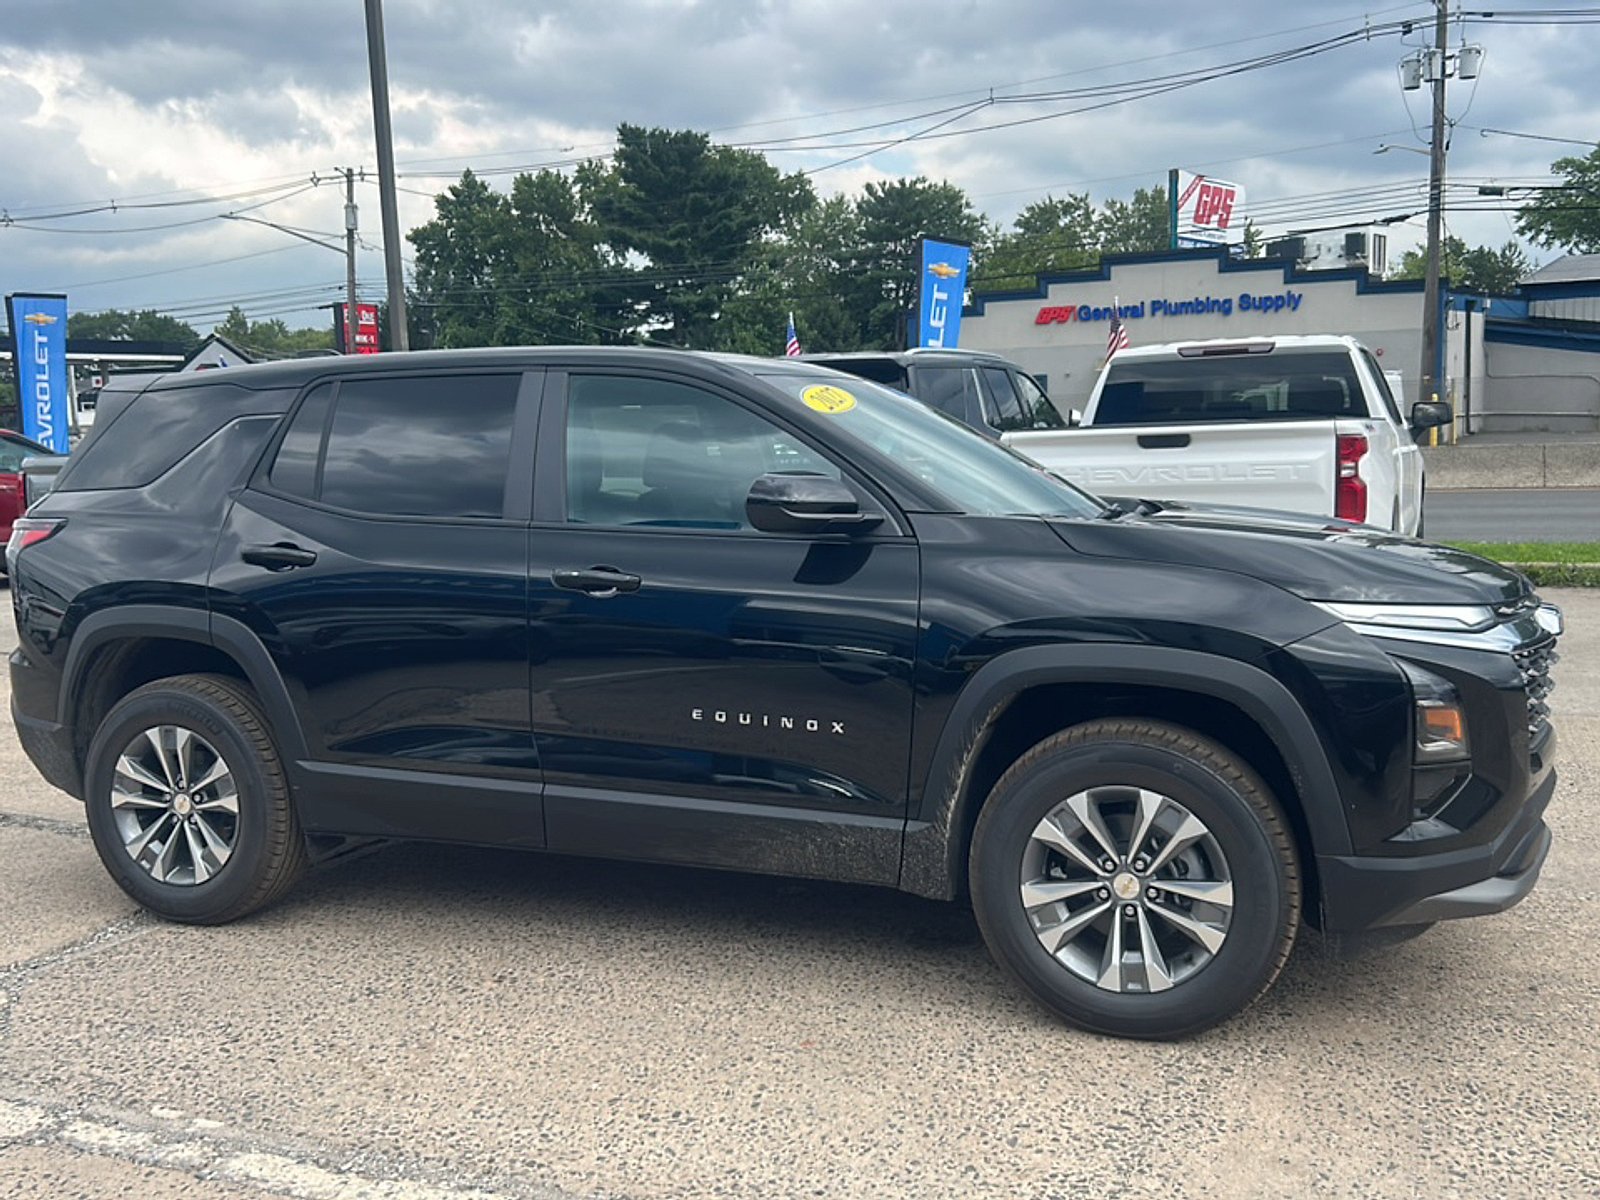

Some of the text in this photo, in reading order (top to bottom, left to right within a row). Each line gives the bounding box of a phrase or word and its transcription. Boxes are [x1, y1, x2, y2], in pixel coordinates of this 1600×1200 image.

[1193, 183, 1236, 229] GPS
[1077, 301, 1145, 321] Genral
[1150, 297, 1234, 317] Plumbing
[1238, 289, 1303, 313] Supply
[691, 708, 845, 734] EQUINOX
